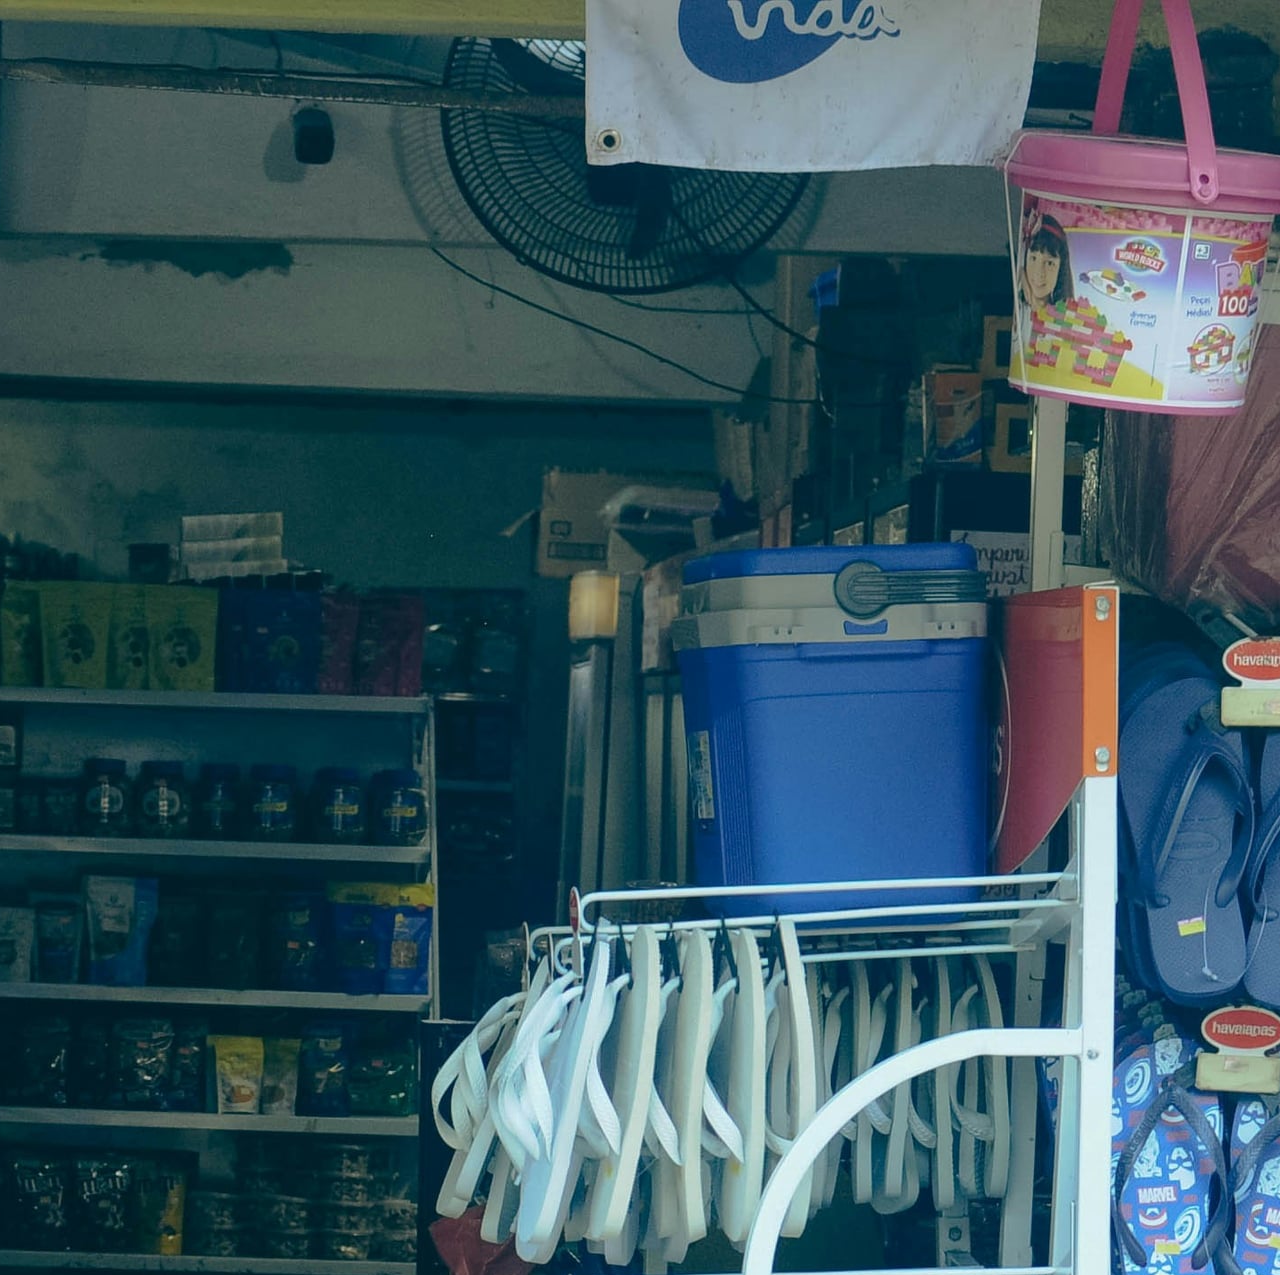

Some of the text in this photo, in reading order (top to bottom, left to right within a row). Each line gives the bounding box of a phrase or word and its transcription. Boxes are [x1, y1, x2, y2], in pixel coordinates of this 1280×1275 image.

[1222, 296, 1247, 315] 100
[1212, 1021, 1276, 1038] havaianas
[1138, 1185, 1177, 1204] MARVEL
